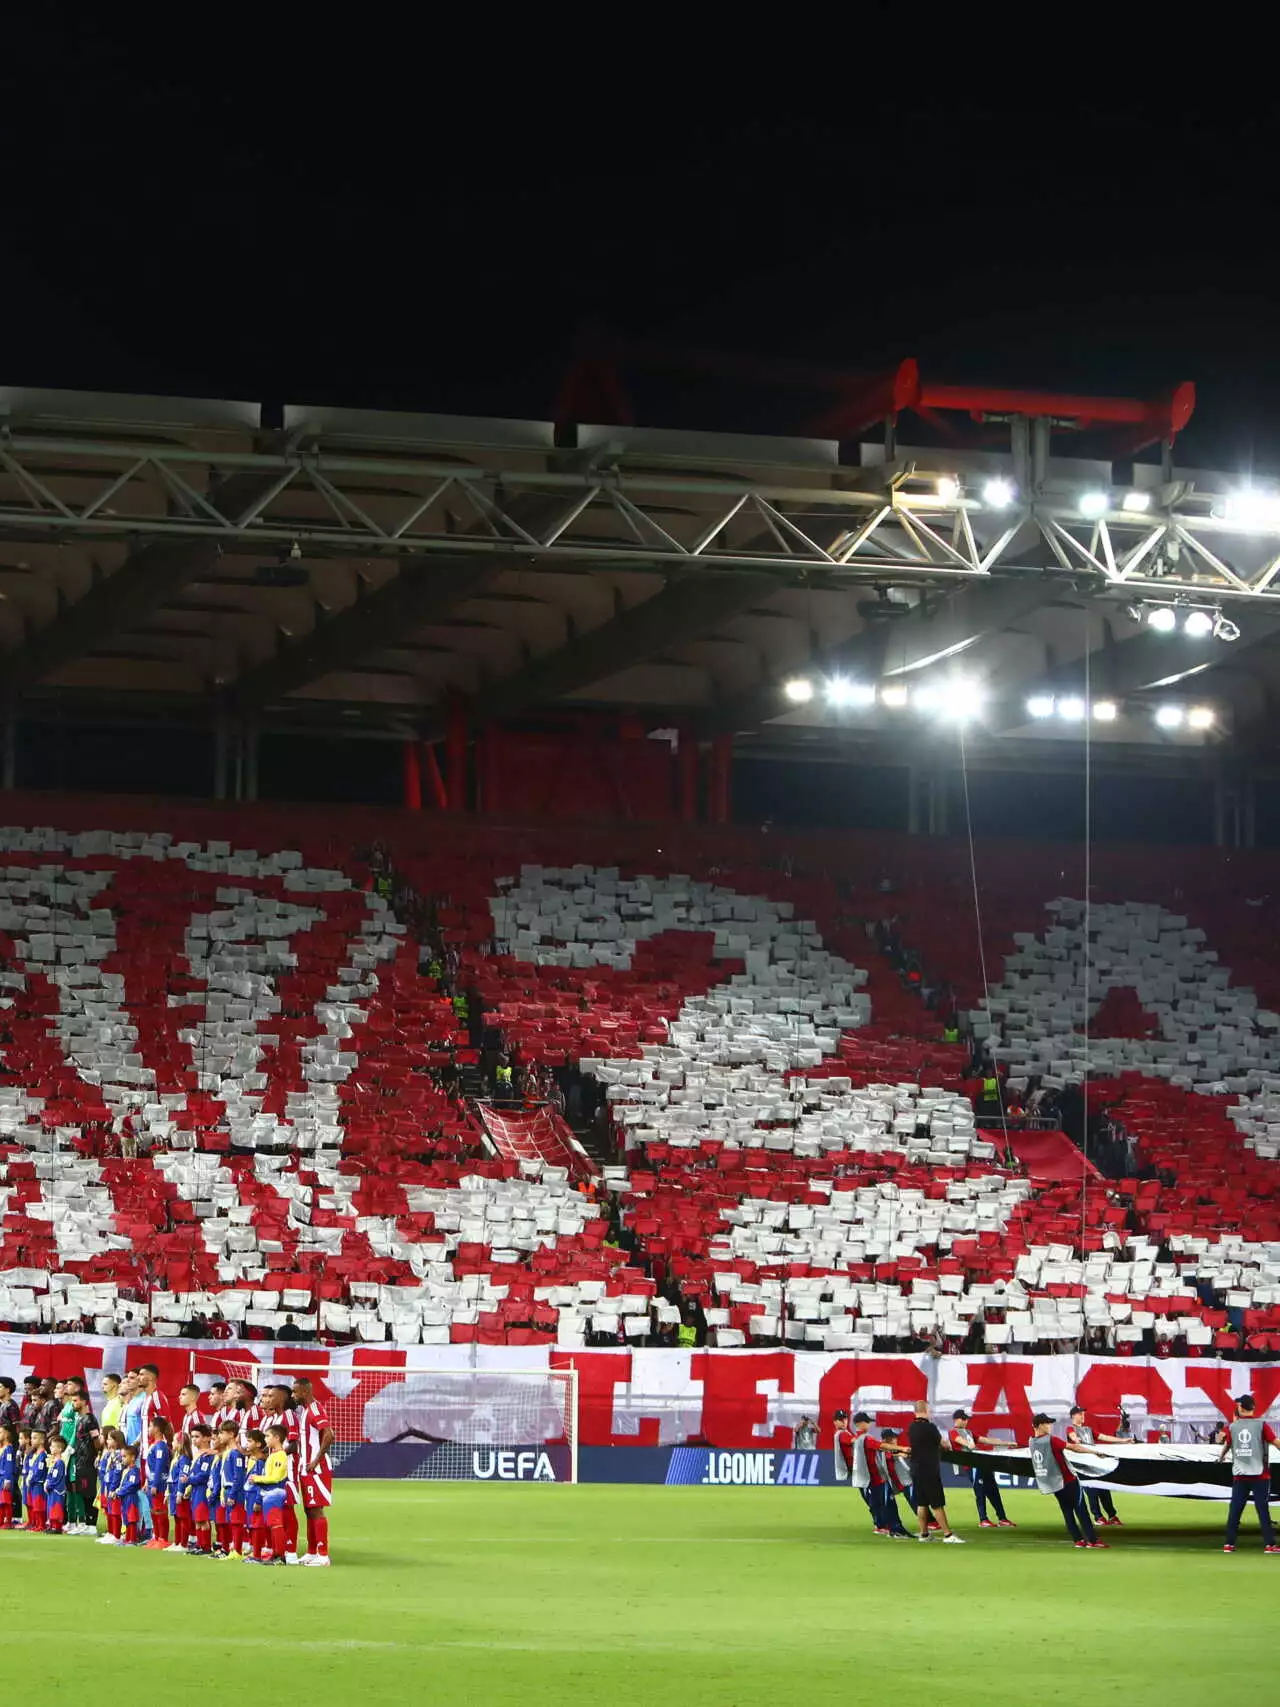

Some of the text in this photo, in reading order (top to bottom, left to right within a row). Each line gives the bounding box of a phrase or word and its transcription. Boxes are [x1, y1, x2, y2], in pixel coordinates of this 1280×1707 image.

[472, 1451, 557, 1480] UEFA
[702, 1452, 820, 1485] LCOME ALL
